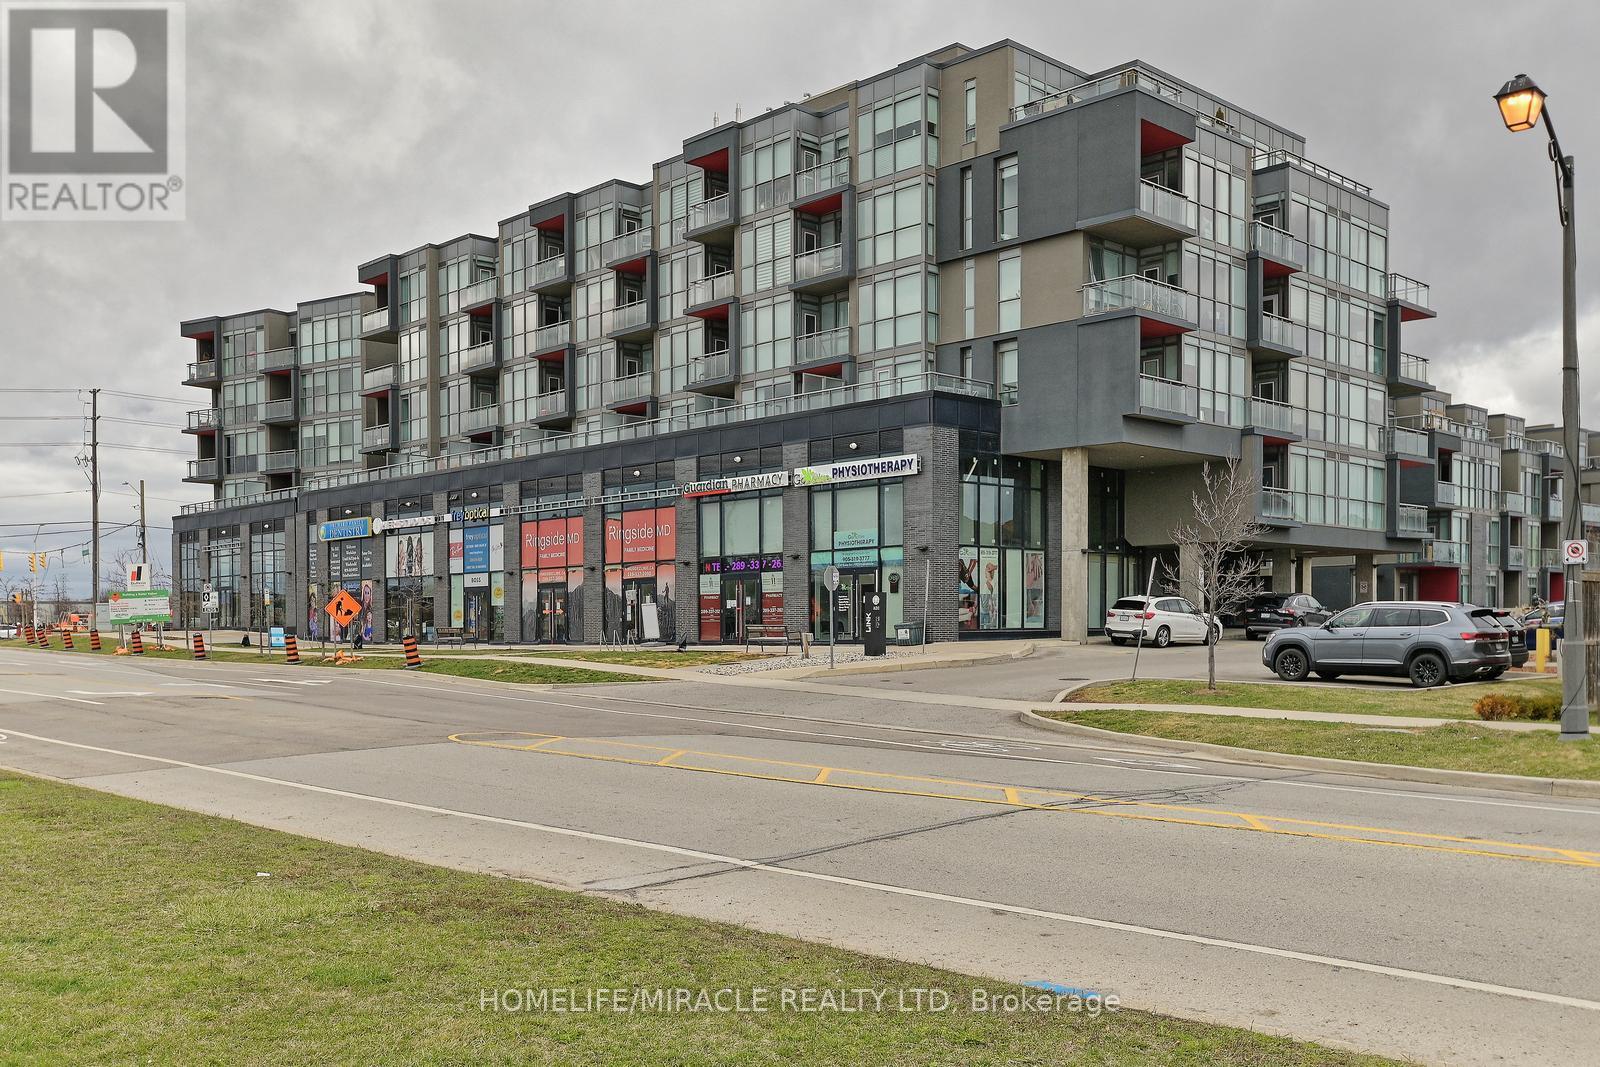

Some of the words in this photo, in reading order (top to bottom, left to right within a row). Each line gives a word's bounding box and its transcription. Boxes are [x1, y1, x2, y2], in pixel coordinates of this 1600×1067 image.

[831, 458, 914, 479] PHYSIOTHERAPY
[683, 478, 729, 493] Guardian
[731, 474, 784, 490] PHARMACY
[329, 526, 363, 539] DENTISTRY
[525, 530, 565, 551] Ringside
[567, 532, 580, 544] MD
[608, 522, 654, 544] Ringside
[656, 524, 671, 537] MD
